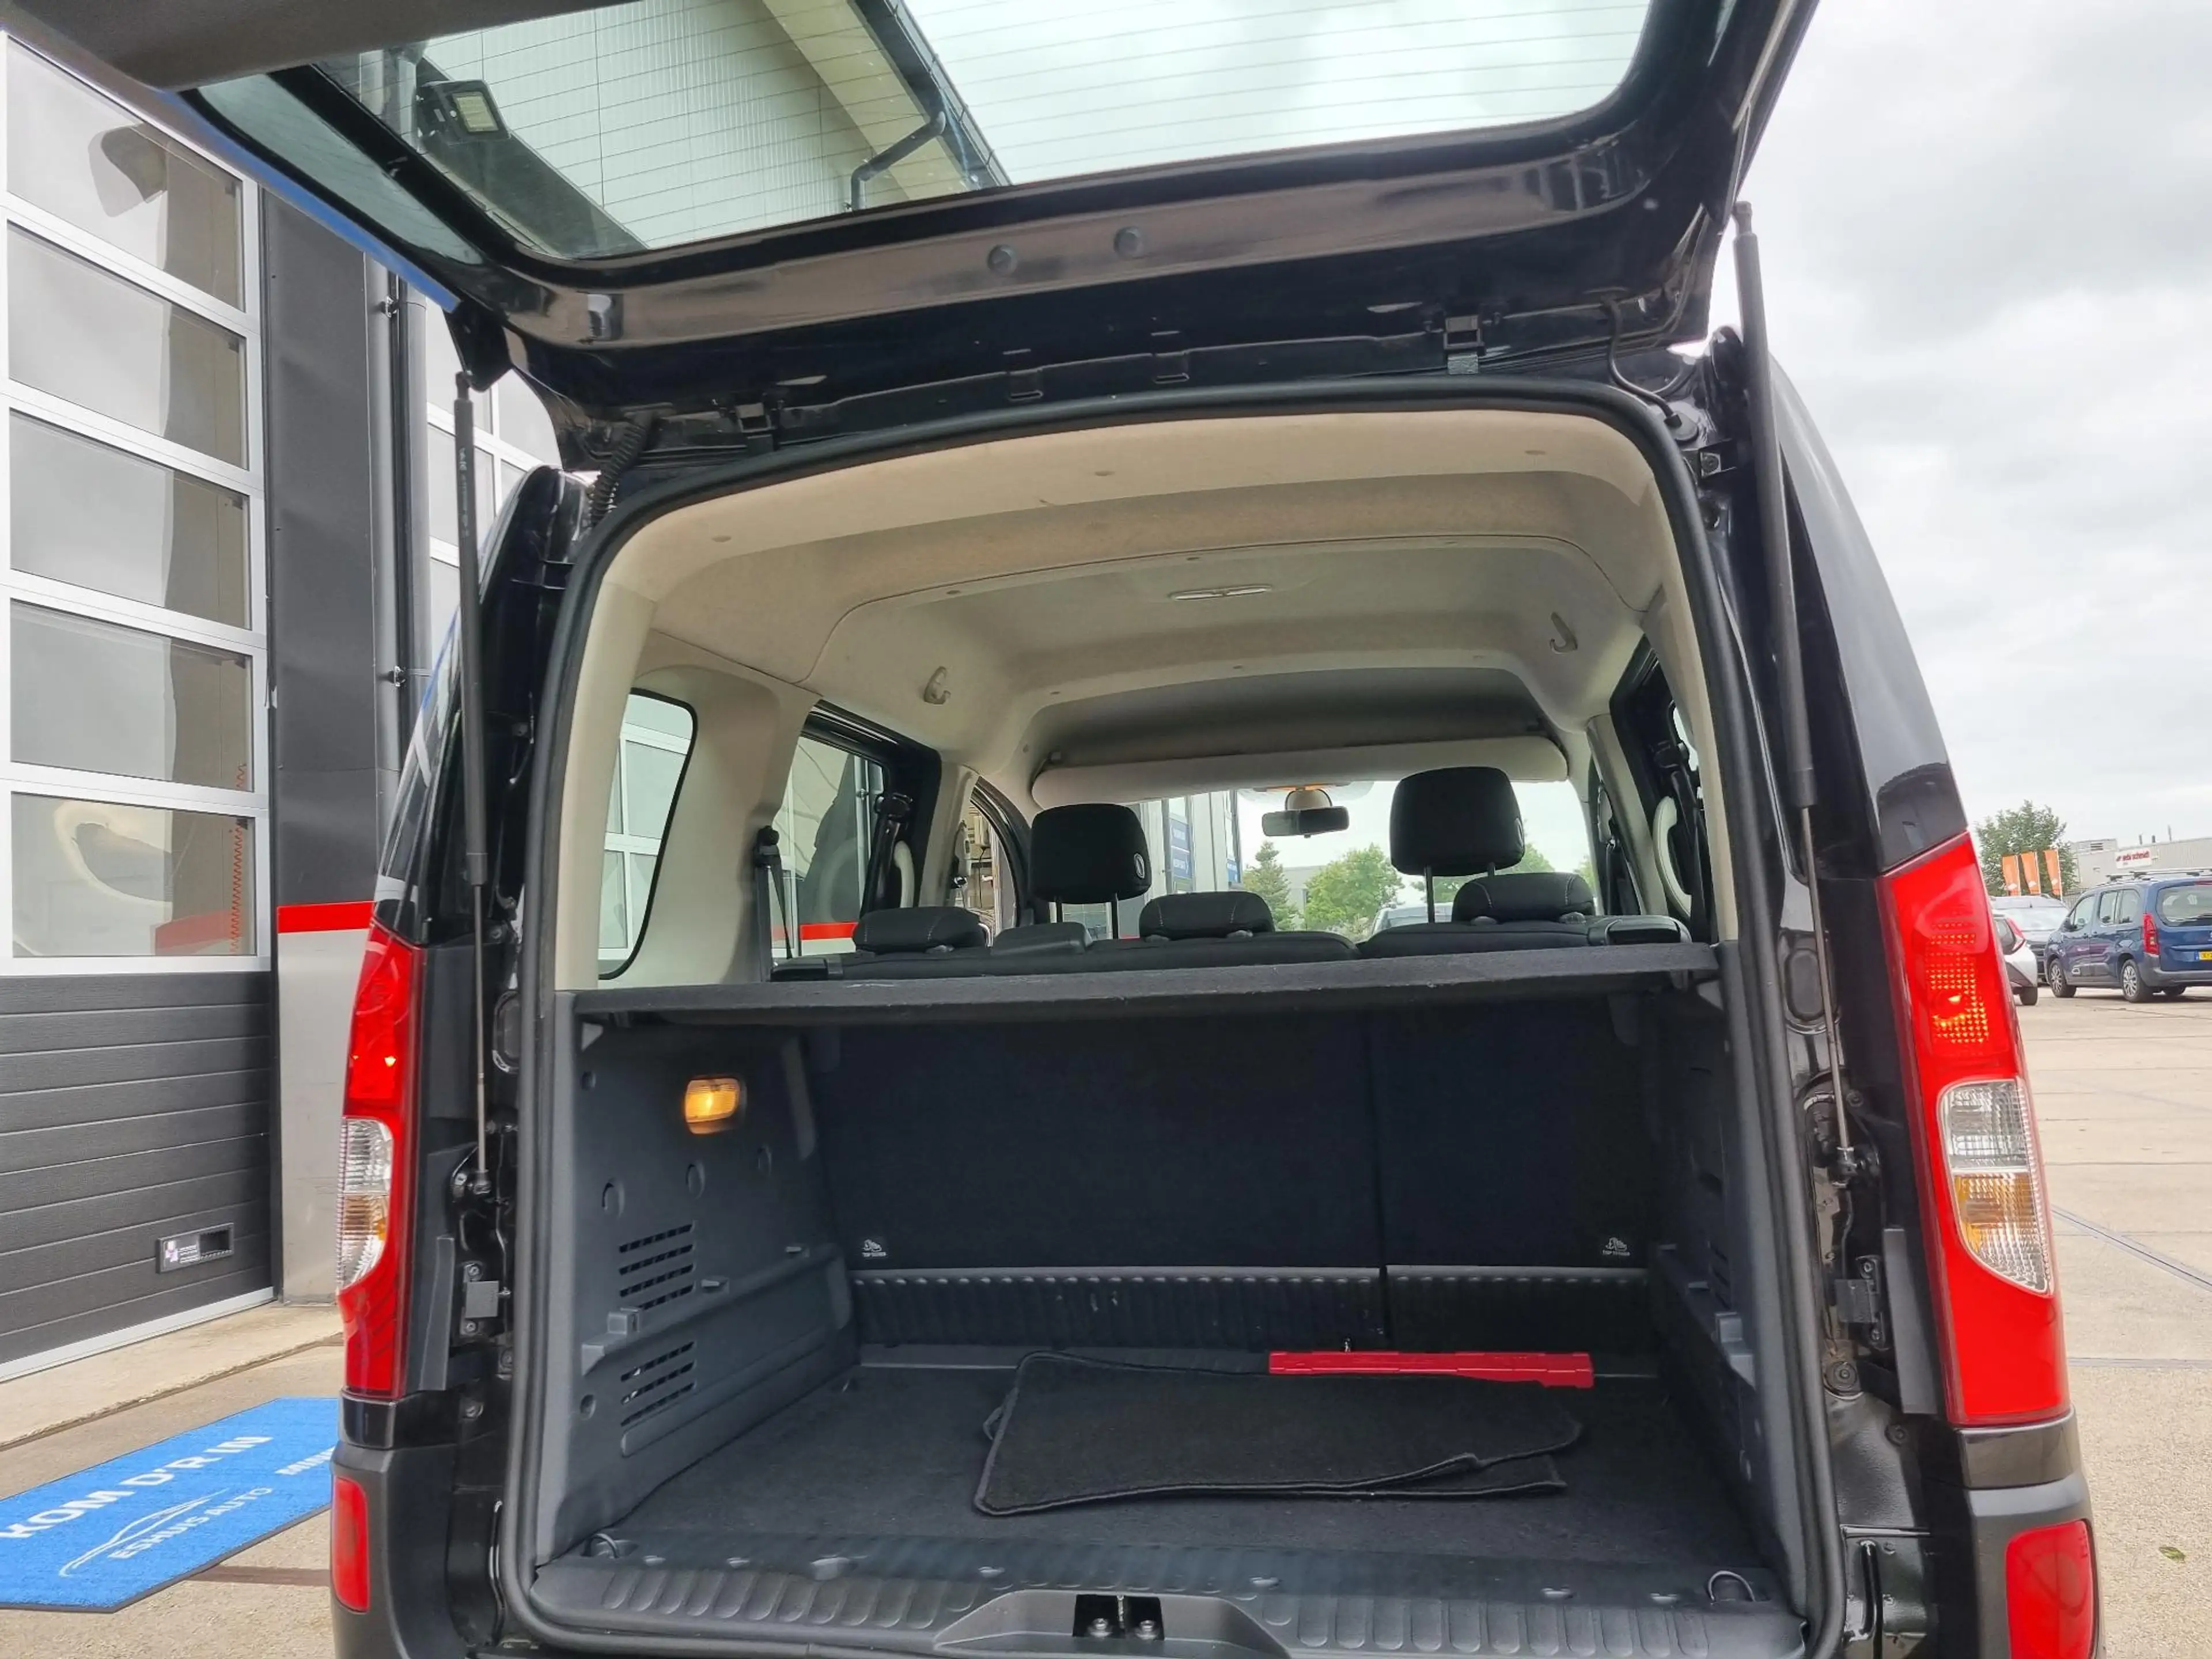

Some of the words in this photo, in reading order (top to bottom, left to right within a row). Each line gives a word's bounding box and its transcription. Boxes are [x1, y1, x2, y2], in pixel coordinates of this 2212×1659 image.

[0, 1491, 136, 1537] KOM
[118, 1456, 222, 1486] D'R
[203, 1437, 274, 1453] IN
[107, 1516, 210, 1559] ESHUIS
[204, 1487, 273, 1516] AUTO
